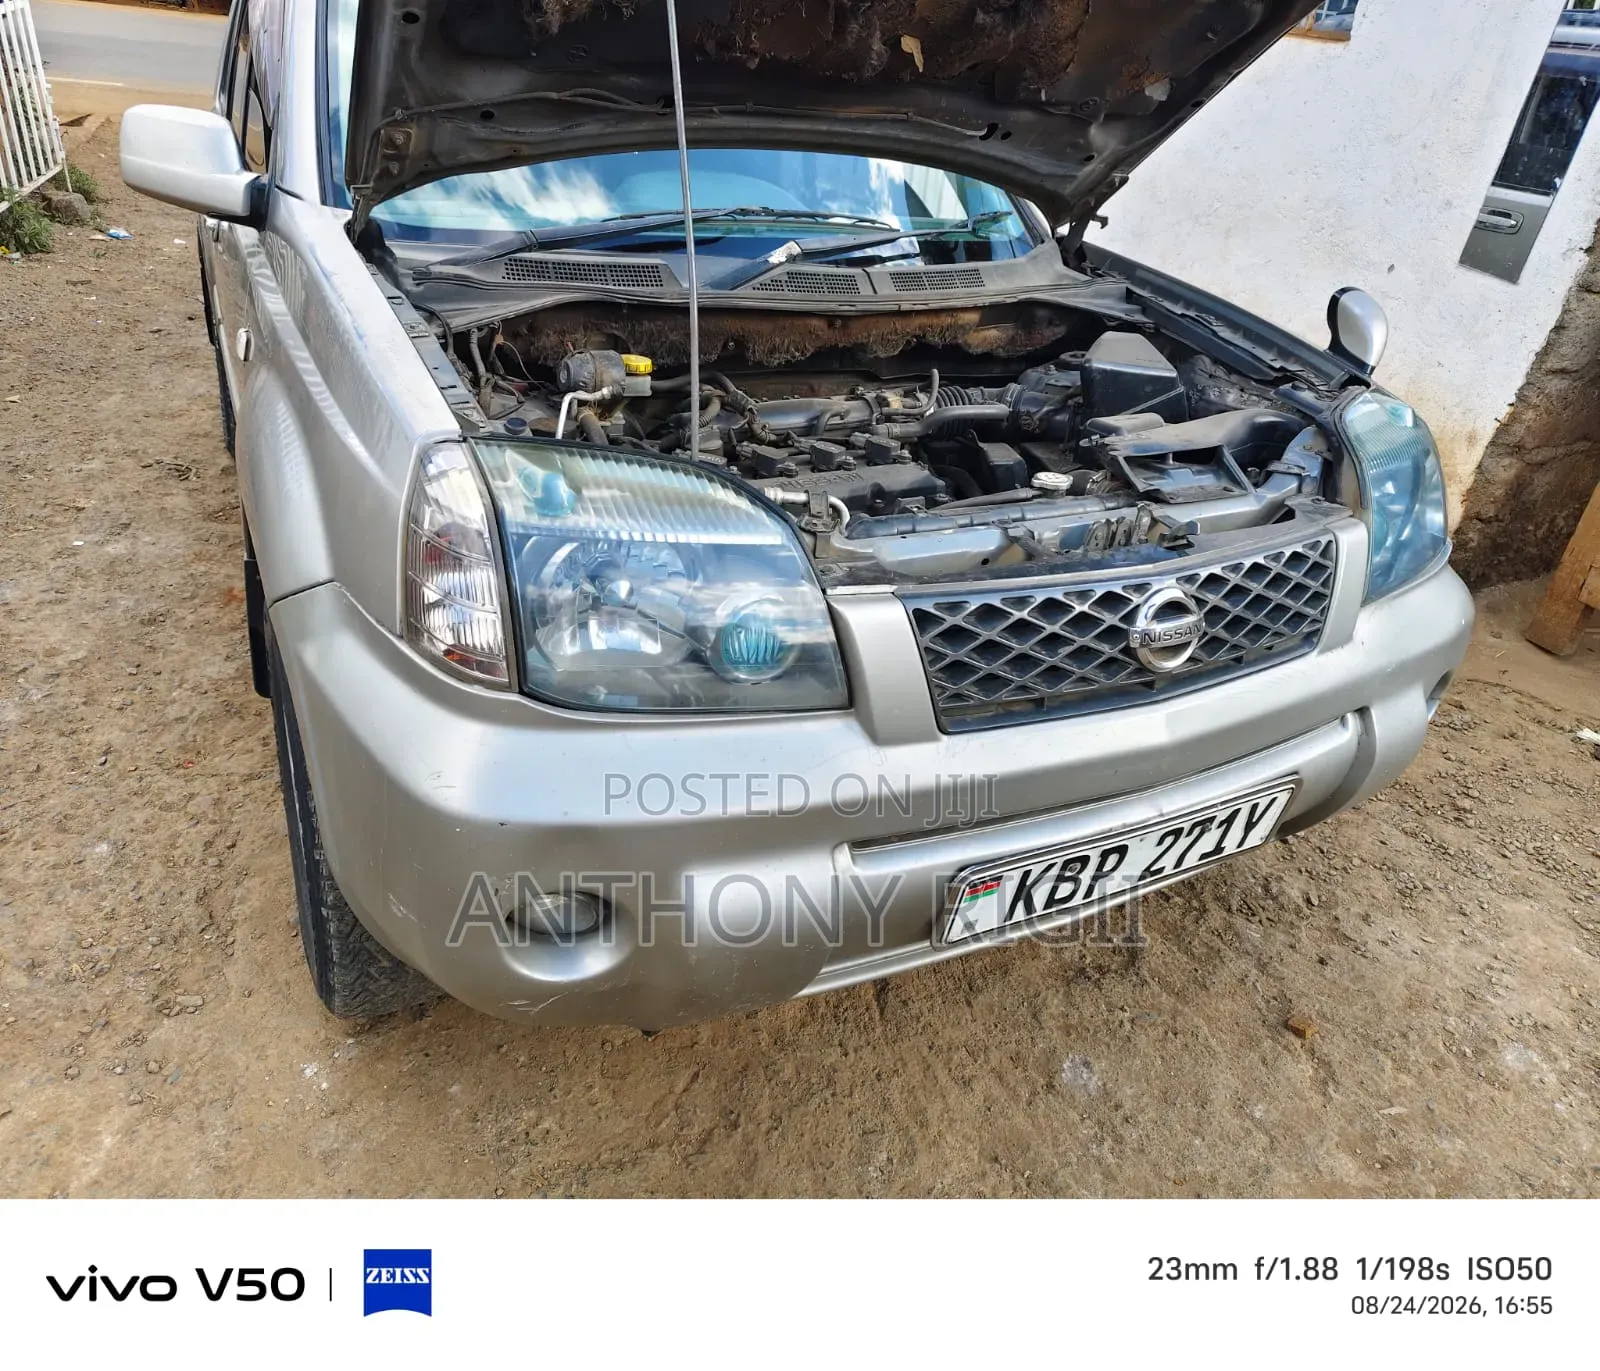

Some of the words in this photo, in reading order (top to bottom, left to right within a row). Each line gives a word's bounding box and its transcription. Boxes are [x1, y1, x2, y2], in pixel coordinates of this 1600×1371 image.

[1142, 622, 1204, 644] NISSAN
[1003, 844, 1129, 923] KBP
[1138, 796, 1279, 882] 271Y
